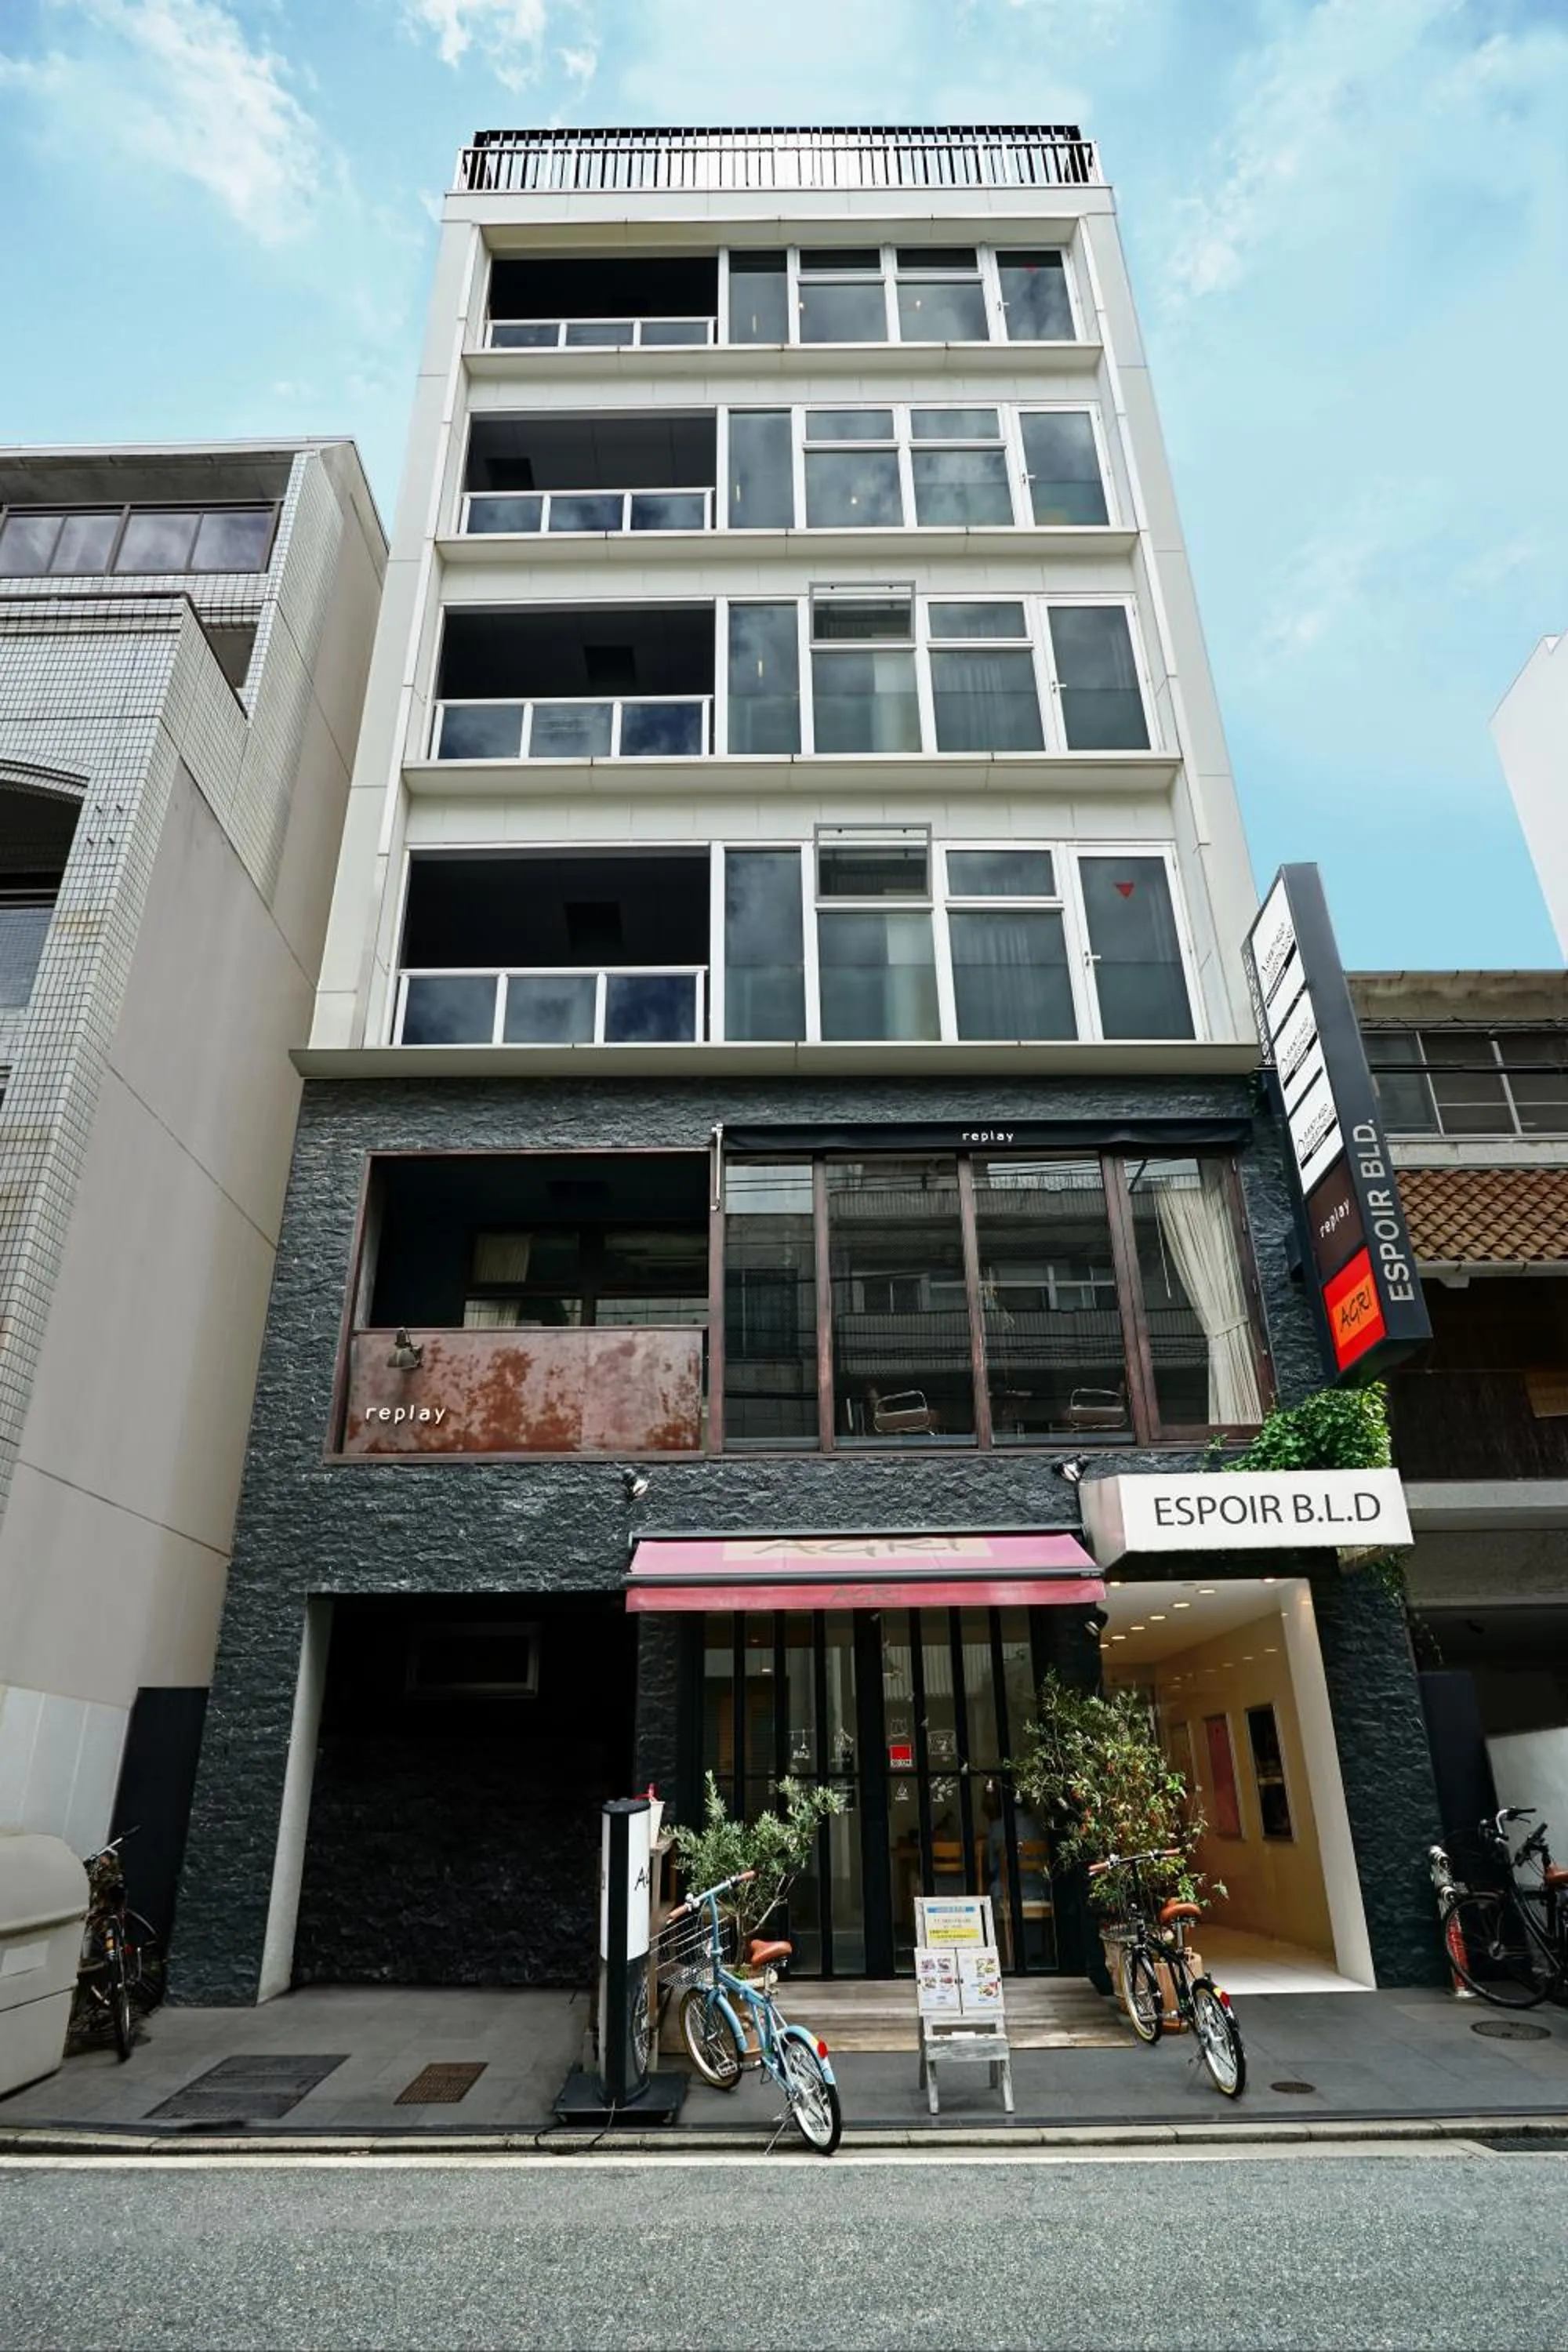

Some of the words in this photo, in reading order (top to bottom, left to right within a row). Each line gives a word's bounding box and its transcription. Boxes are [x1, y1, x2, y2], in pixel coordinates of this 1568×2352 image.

[962, 1130, 1014, 1142] replay
[1352, 1118, 1387, 1178] BLD.
[1319, 1198, 1350, 1239] replay
[1367, 1189, 1415, 1301] ESPOIR
[1339, 1285, 1373, 1333] AGRI
[365, 1404, 446, 1425] replay
[1153, 1494, 1283, 1526] ESPOIR
[1292, 1492, 1381, 1523] B.L.D
